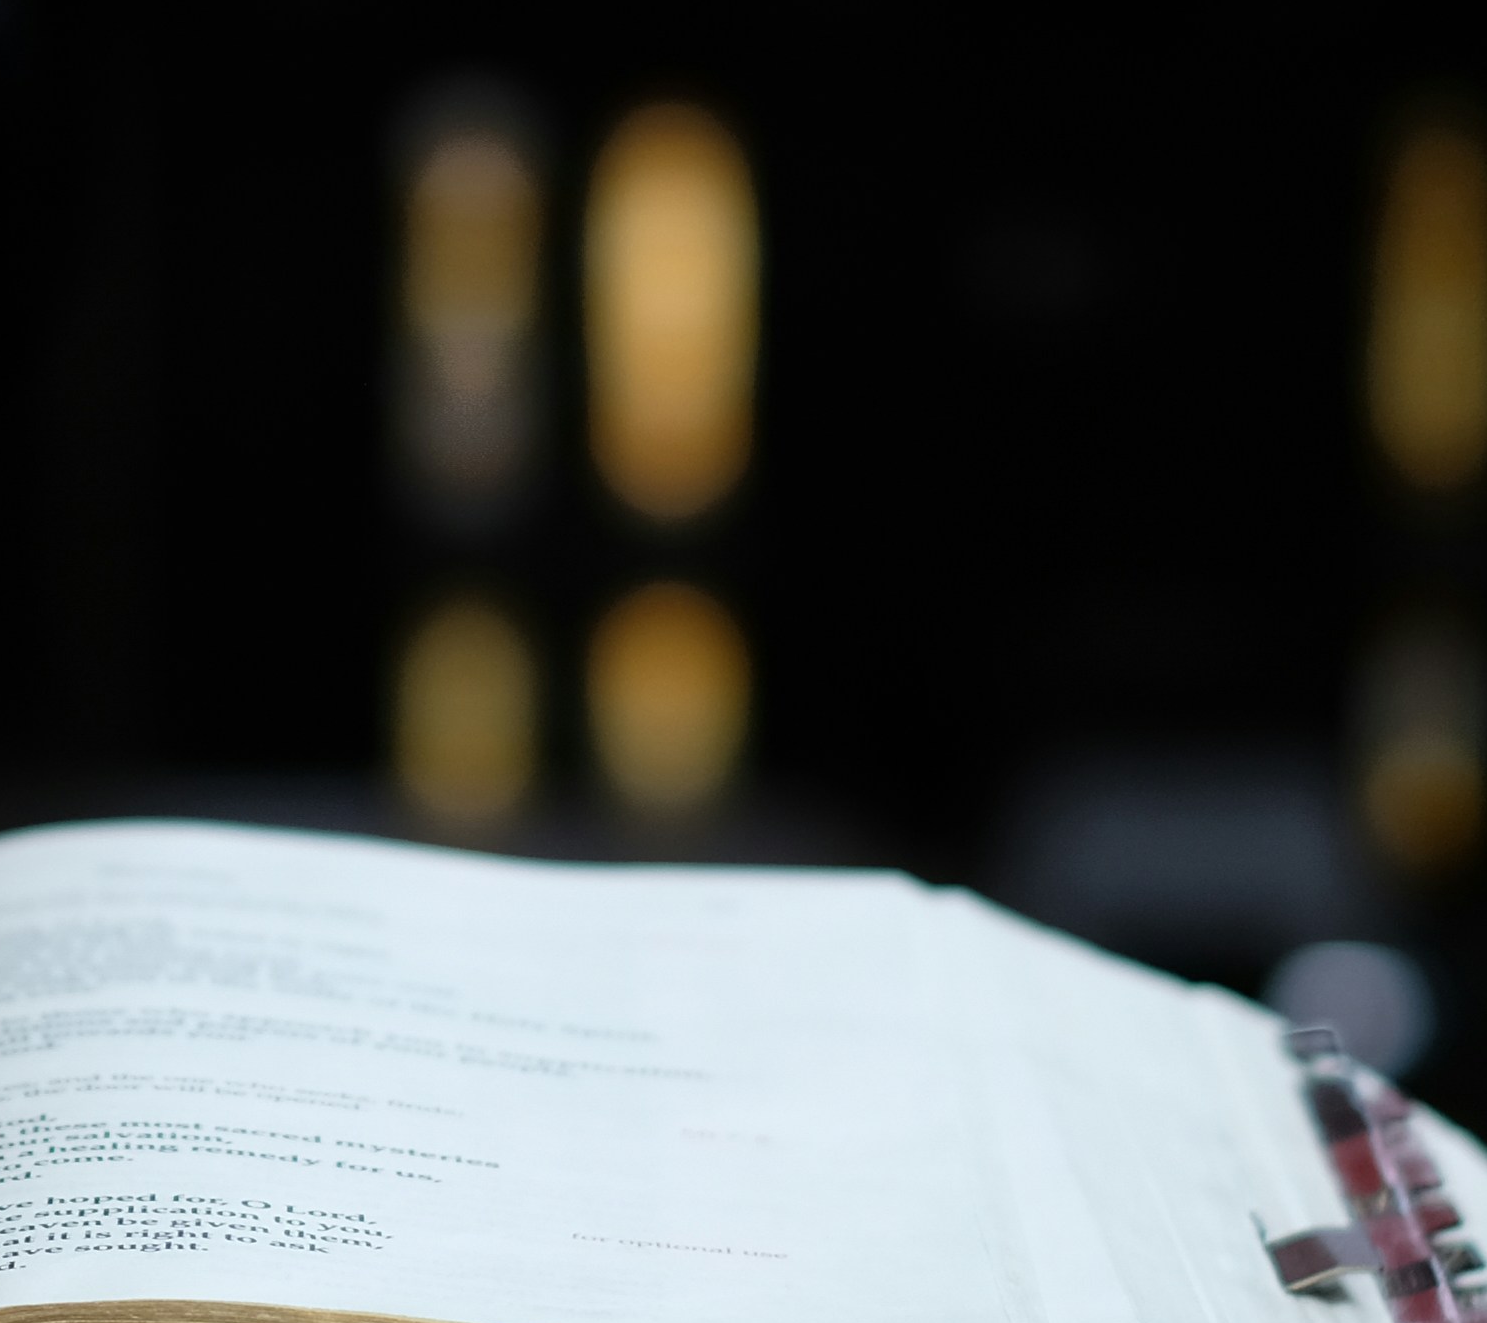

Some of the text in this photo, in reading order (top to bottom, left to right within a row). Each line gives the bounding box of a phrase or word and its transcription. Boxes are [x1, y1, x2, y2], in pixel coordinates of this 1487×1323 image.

[19, 1122, 108, 1136] these
[120, 1121, 203, 1131] most
[214, 1125, 322, 1144] sacred
[335, 1139, 501, 1169] mysteries
[64, 1129, 233, 1146] salvation,
[18, 1150, 35, 1160] a
[47, 1141, 178, 1154] healing
[190, 1145, 321, 1167] remedy
[334, 1159, 384, 1174] for
[395, 1169, 442, 1184] us,
[33, 1155, 134, 1167] come.
[34, 1208, 260, 1221] supplication
[274, 1215, 307, 1227] to
[317, 1222, 393, 1240] you,
[47, 1193, 157, 1206] hoped
[172, 1193, 228, 1207] for,
[240, 1199, 272, 1210] O
[285, 1204, 377, 1226] Lord,
[47, 1232, 71, 1241] it
[85, 1230, 112, 1239] is
[126, 1229, 212, 1241] right
[224, 1234, 258, 1244] to
[269, 1240, 330, 1254] ask
[75, 1241, 209, 1253] sought.
[117, 1217, 159, 1227] be
[170, 1218, 271, 1234] given
[283, 1229, 383, 1251] them,
[571, 1232, 789, 1260] for optional use
